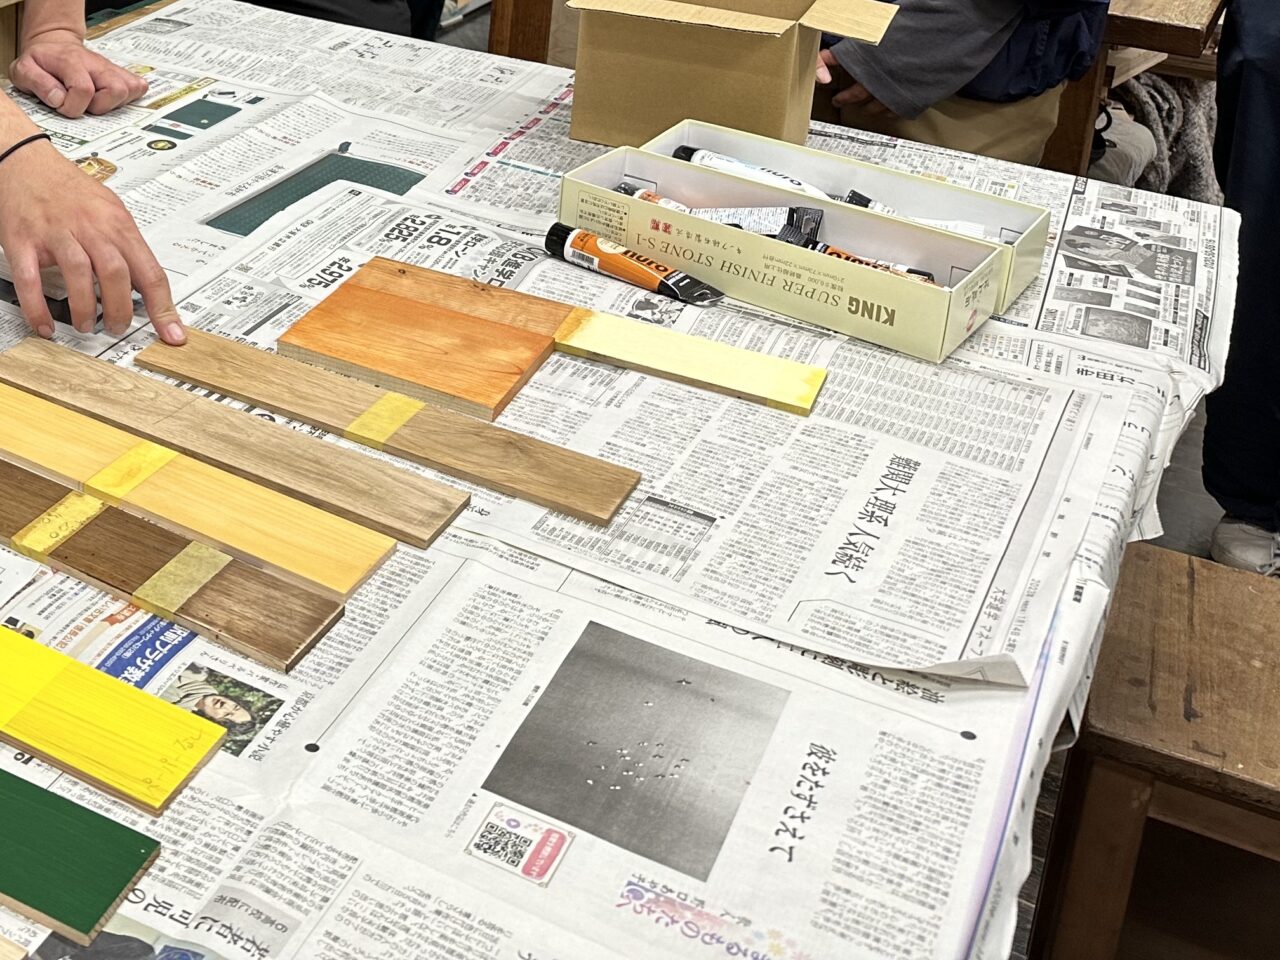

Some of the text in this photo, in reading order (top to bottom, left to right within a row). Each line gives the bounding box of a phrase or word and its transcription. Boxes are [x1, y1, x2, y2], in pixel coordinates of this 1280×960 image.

[635, 233, 896, 327] KING SUPER FINISH STONE S-1
[858, 453, 921, 527] 難関大理系
[824, 523, 881, 583] 人気続く
[247, 690, 314, 764] 京都が心癒やす小説
